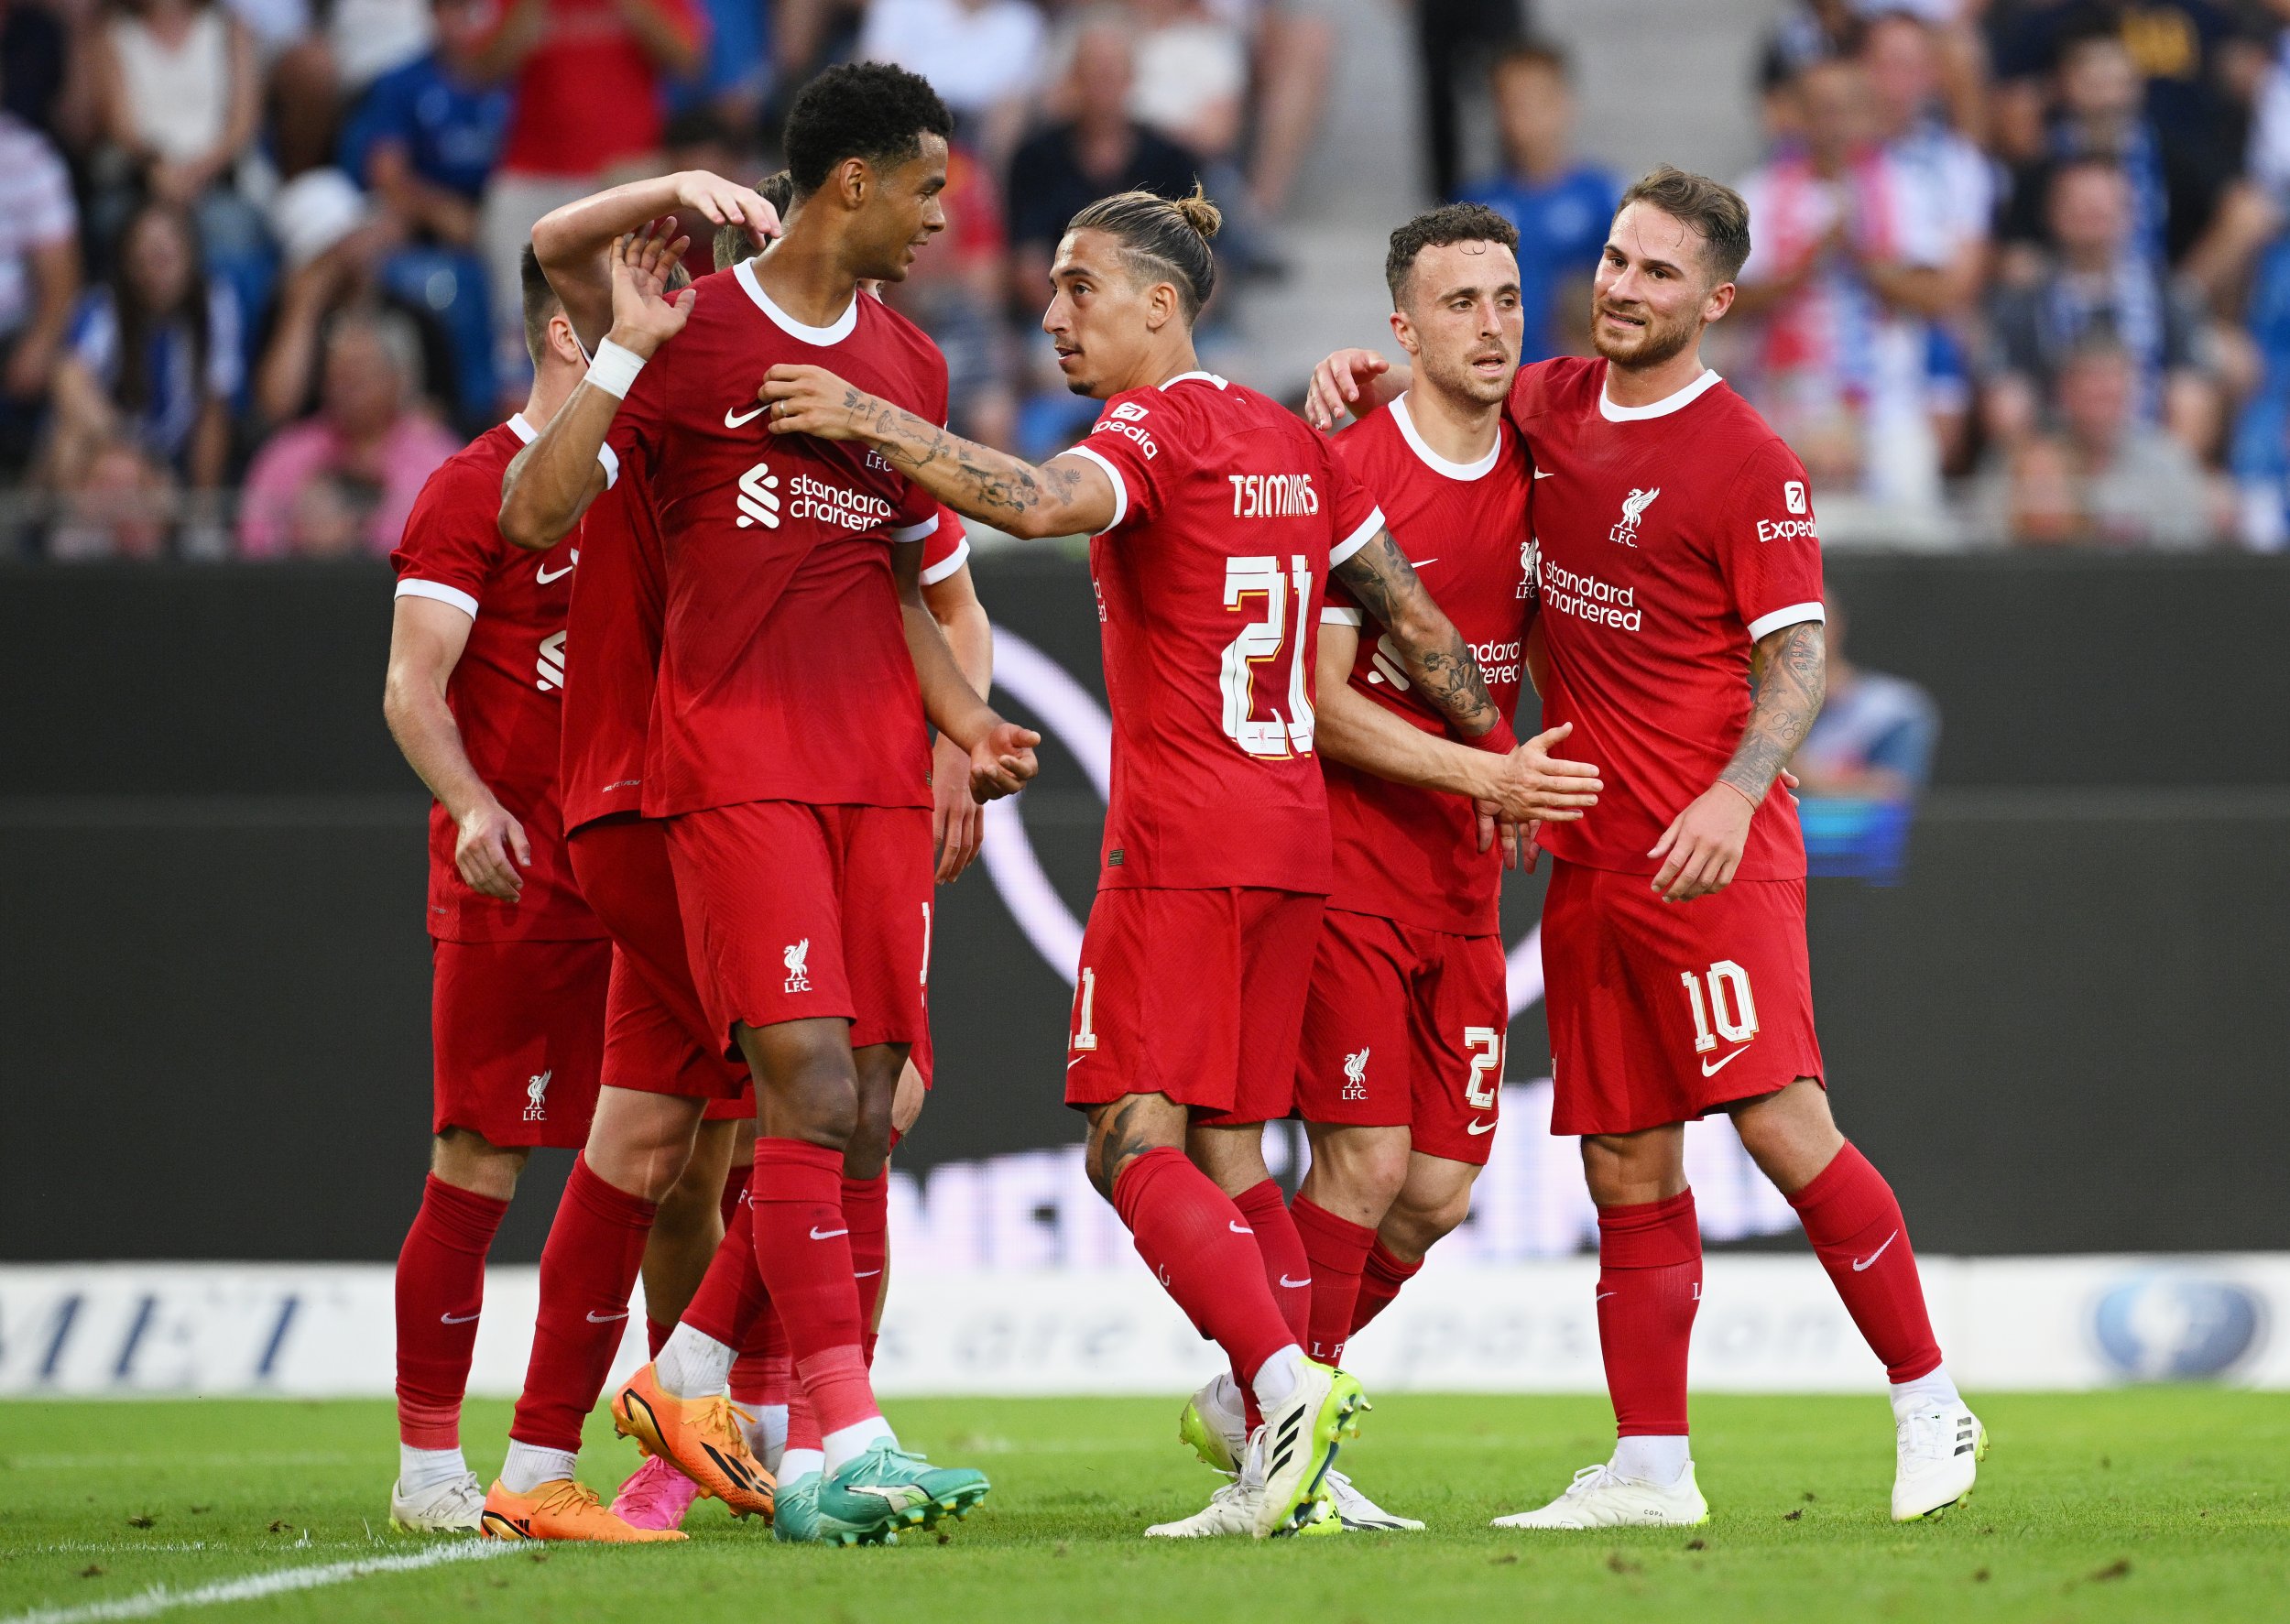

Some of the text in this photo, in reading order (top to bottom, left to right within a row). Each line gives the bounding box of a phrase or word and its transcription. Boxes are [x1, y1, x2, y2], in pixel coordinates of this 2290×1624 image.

[1091, 420, 1159, 461] pedia
[1228, 474, 1319, 518] TSIMIKAS
[1545, 560, 1634, 608] standard
[1219, 554, 1316, 761] 21
[1680, 959, 1760, 1054] 10
[1464, 1026, 1507, 1111] 2
